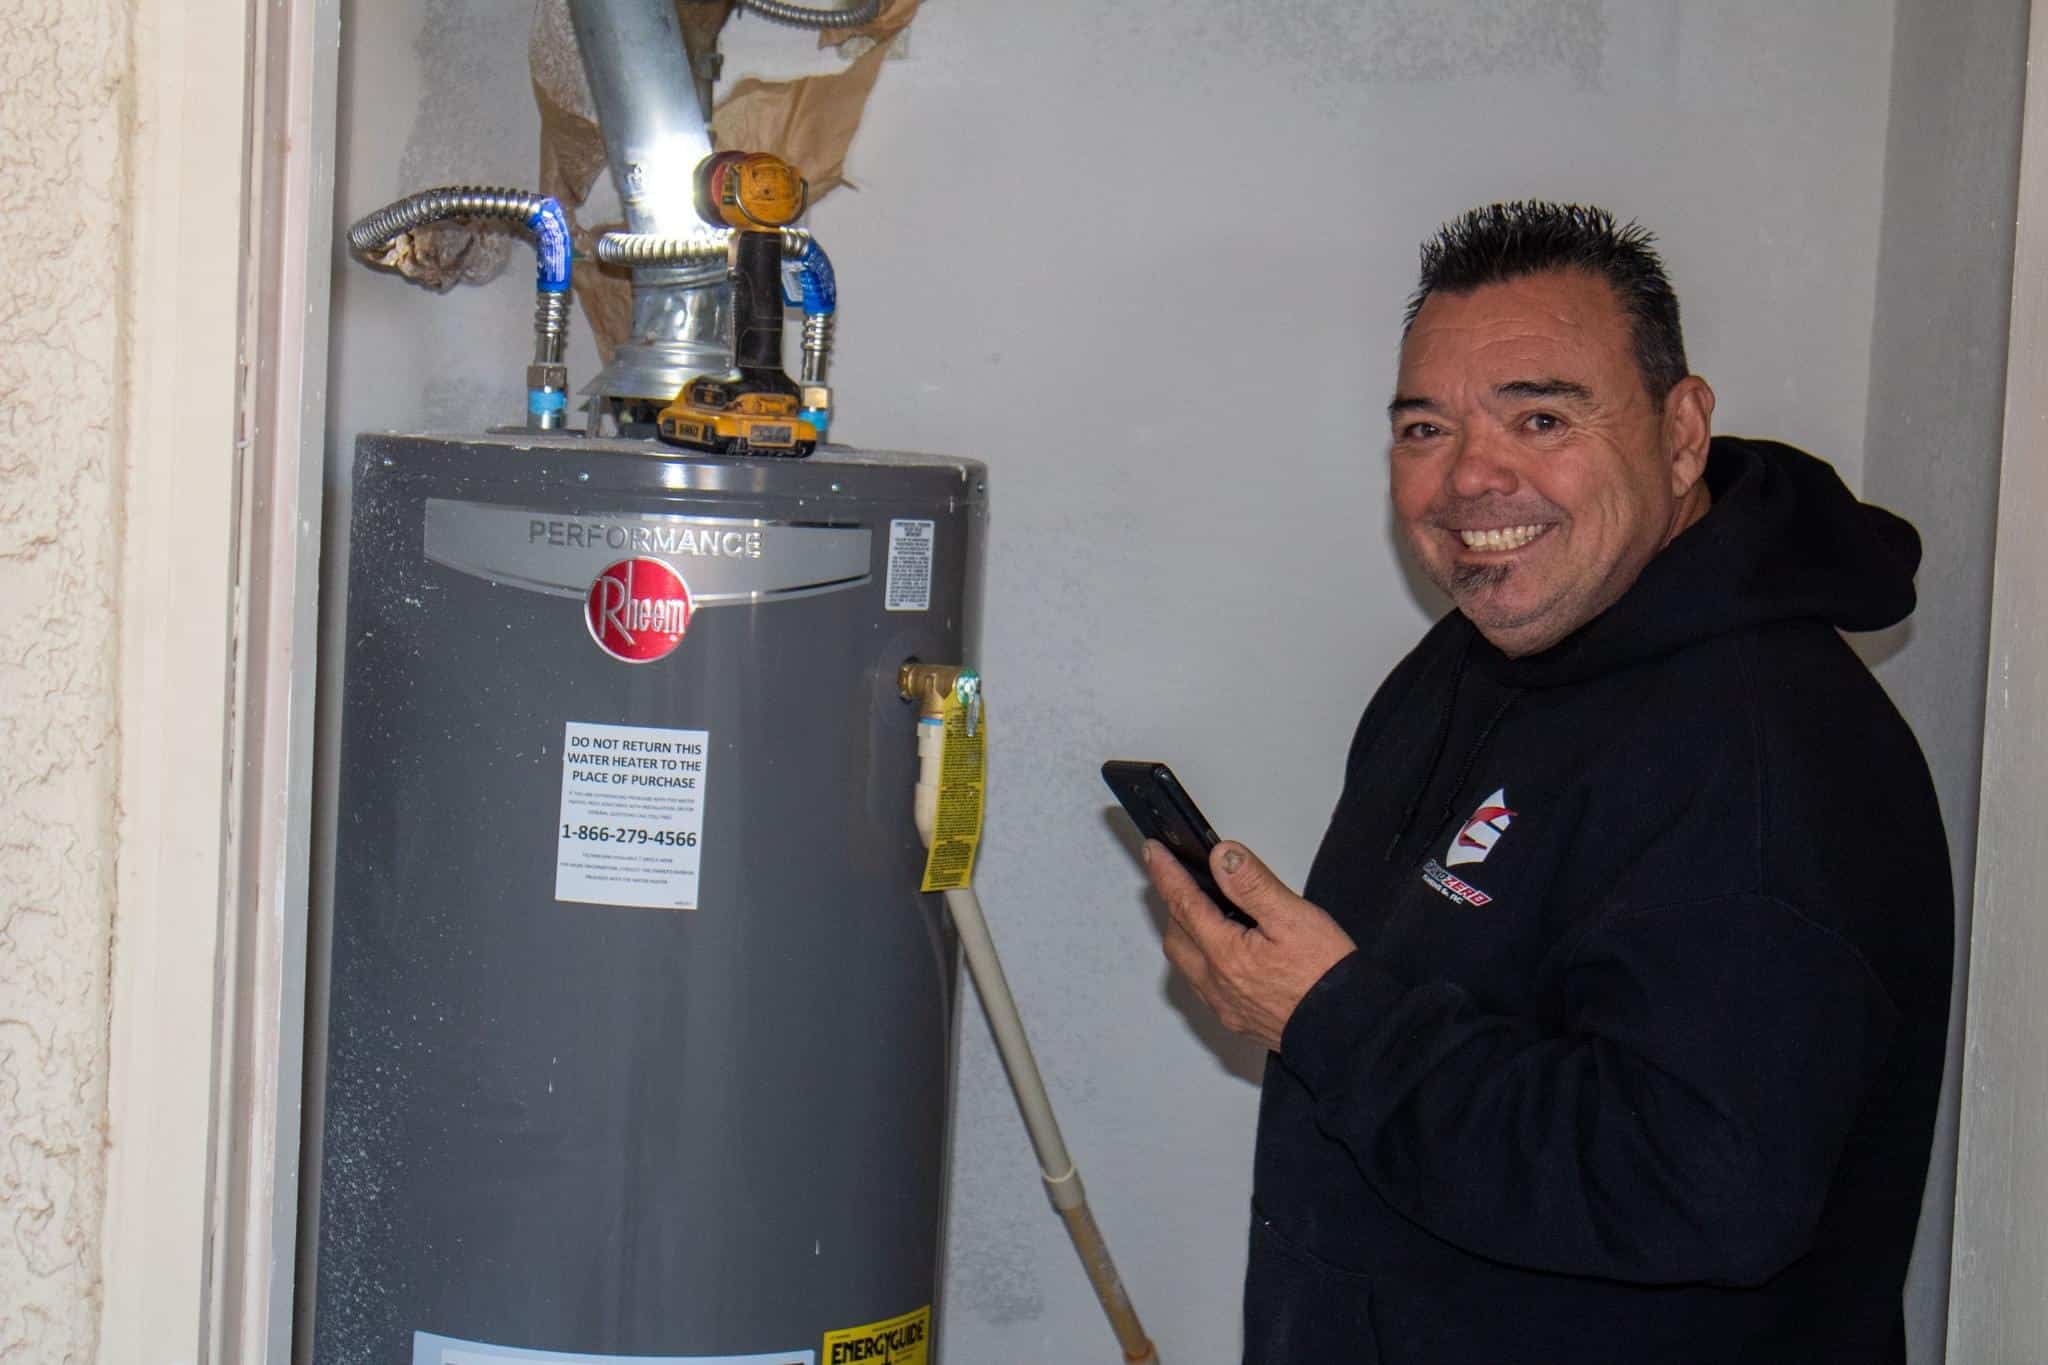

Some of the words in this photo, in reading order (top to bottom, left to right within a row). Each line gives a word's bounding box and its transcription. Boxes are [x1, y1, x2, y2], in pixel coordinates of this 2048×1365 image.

[528, 519, 761, 559] PERFORMANCE
[594, 560, 685, 645] Rheem
[571, 736, 590, 748] DO
[592, 738, 619, 750] NOT
[622, 740, 671, 753] RETURN
[674, 743, 702, 755] THIS
[567, 752, 609, 766] WATER
[612, 755, 657, 769] HEATER
[660, 759, 677, 770] TO
[680, 760, 702, 772] THE
[572, 770, 609, 784] PLACE
[611, 773, 628, 784] OF
[631, 775, 696, 789] PURCHASE
[562, 823, 697, 848] 1-866-279-4566
